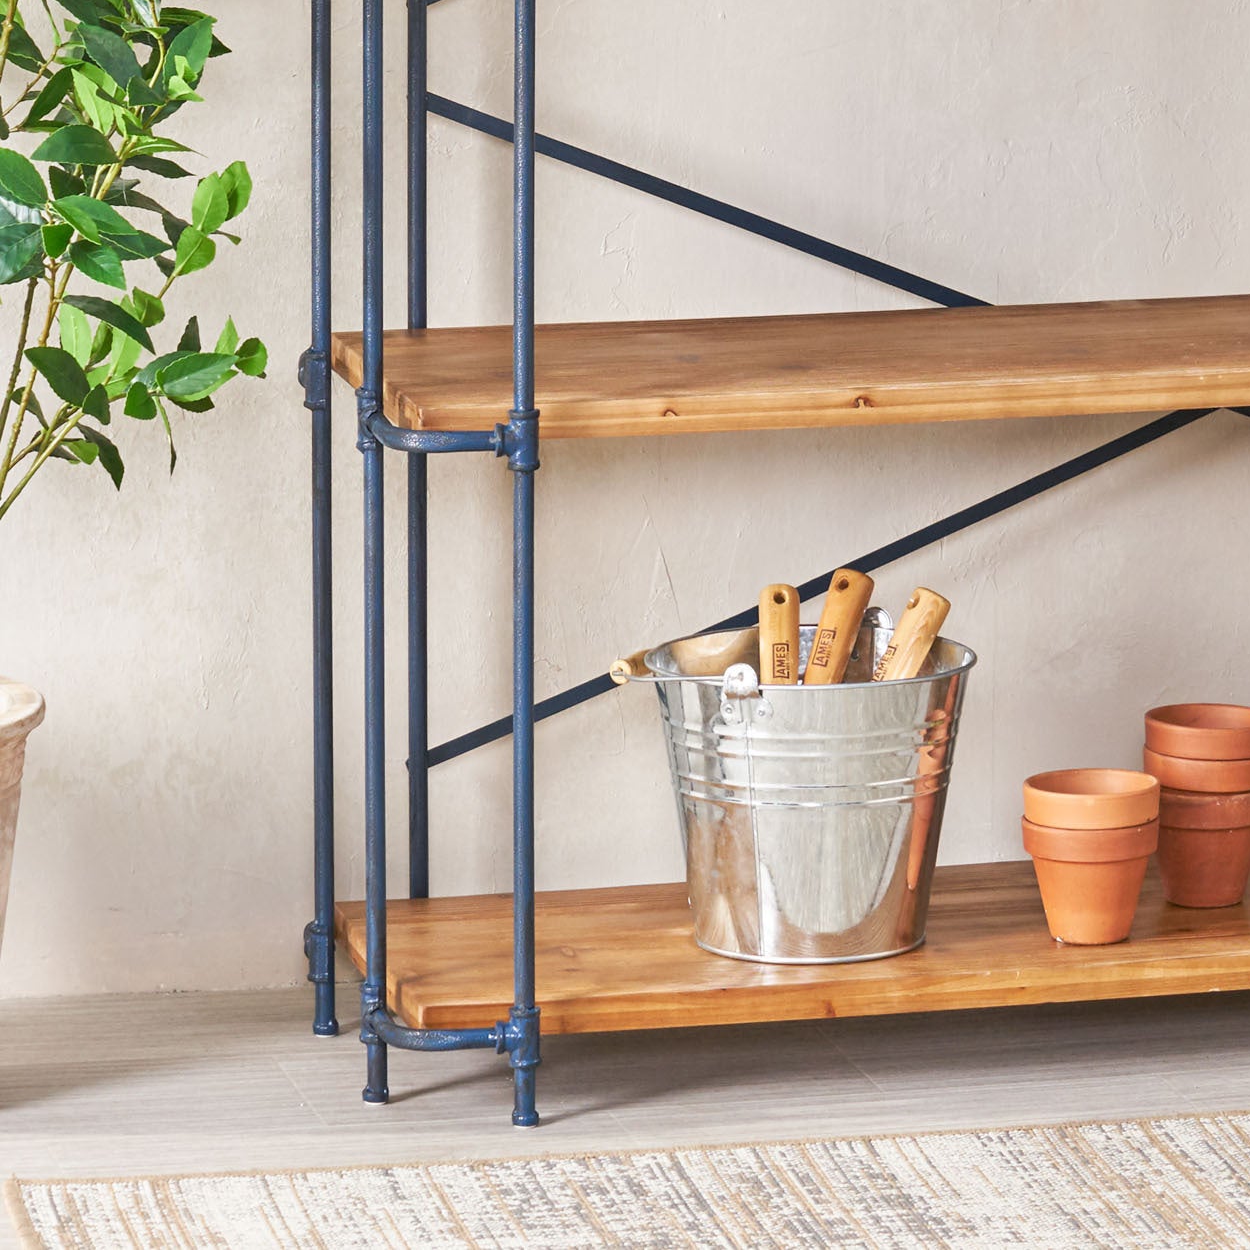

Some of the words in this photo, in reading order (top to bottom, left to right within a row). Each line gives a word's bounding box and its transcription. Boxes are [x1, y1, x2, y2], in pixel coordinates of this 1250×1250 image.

[776, 646, 786, 676] AMES
[816, 632, 831, 663] AMES
[875, 648, 892, 679] AMES
